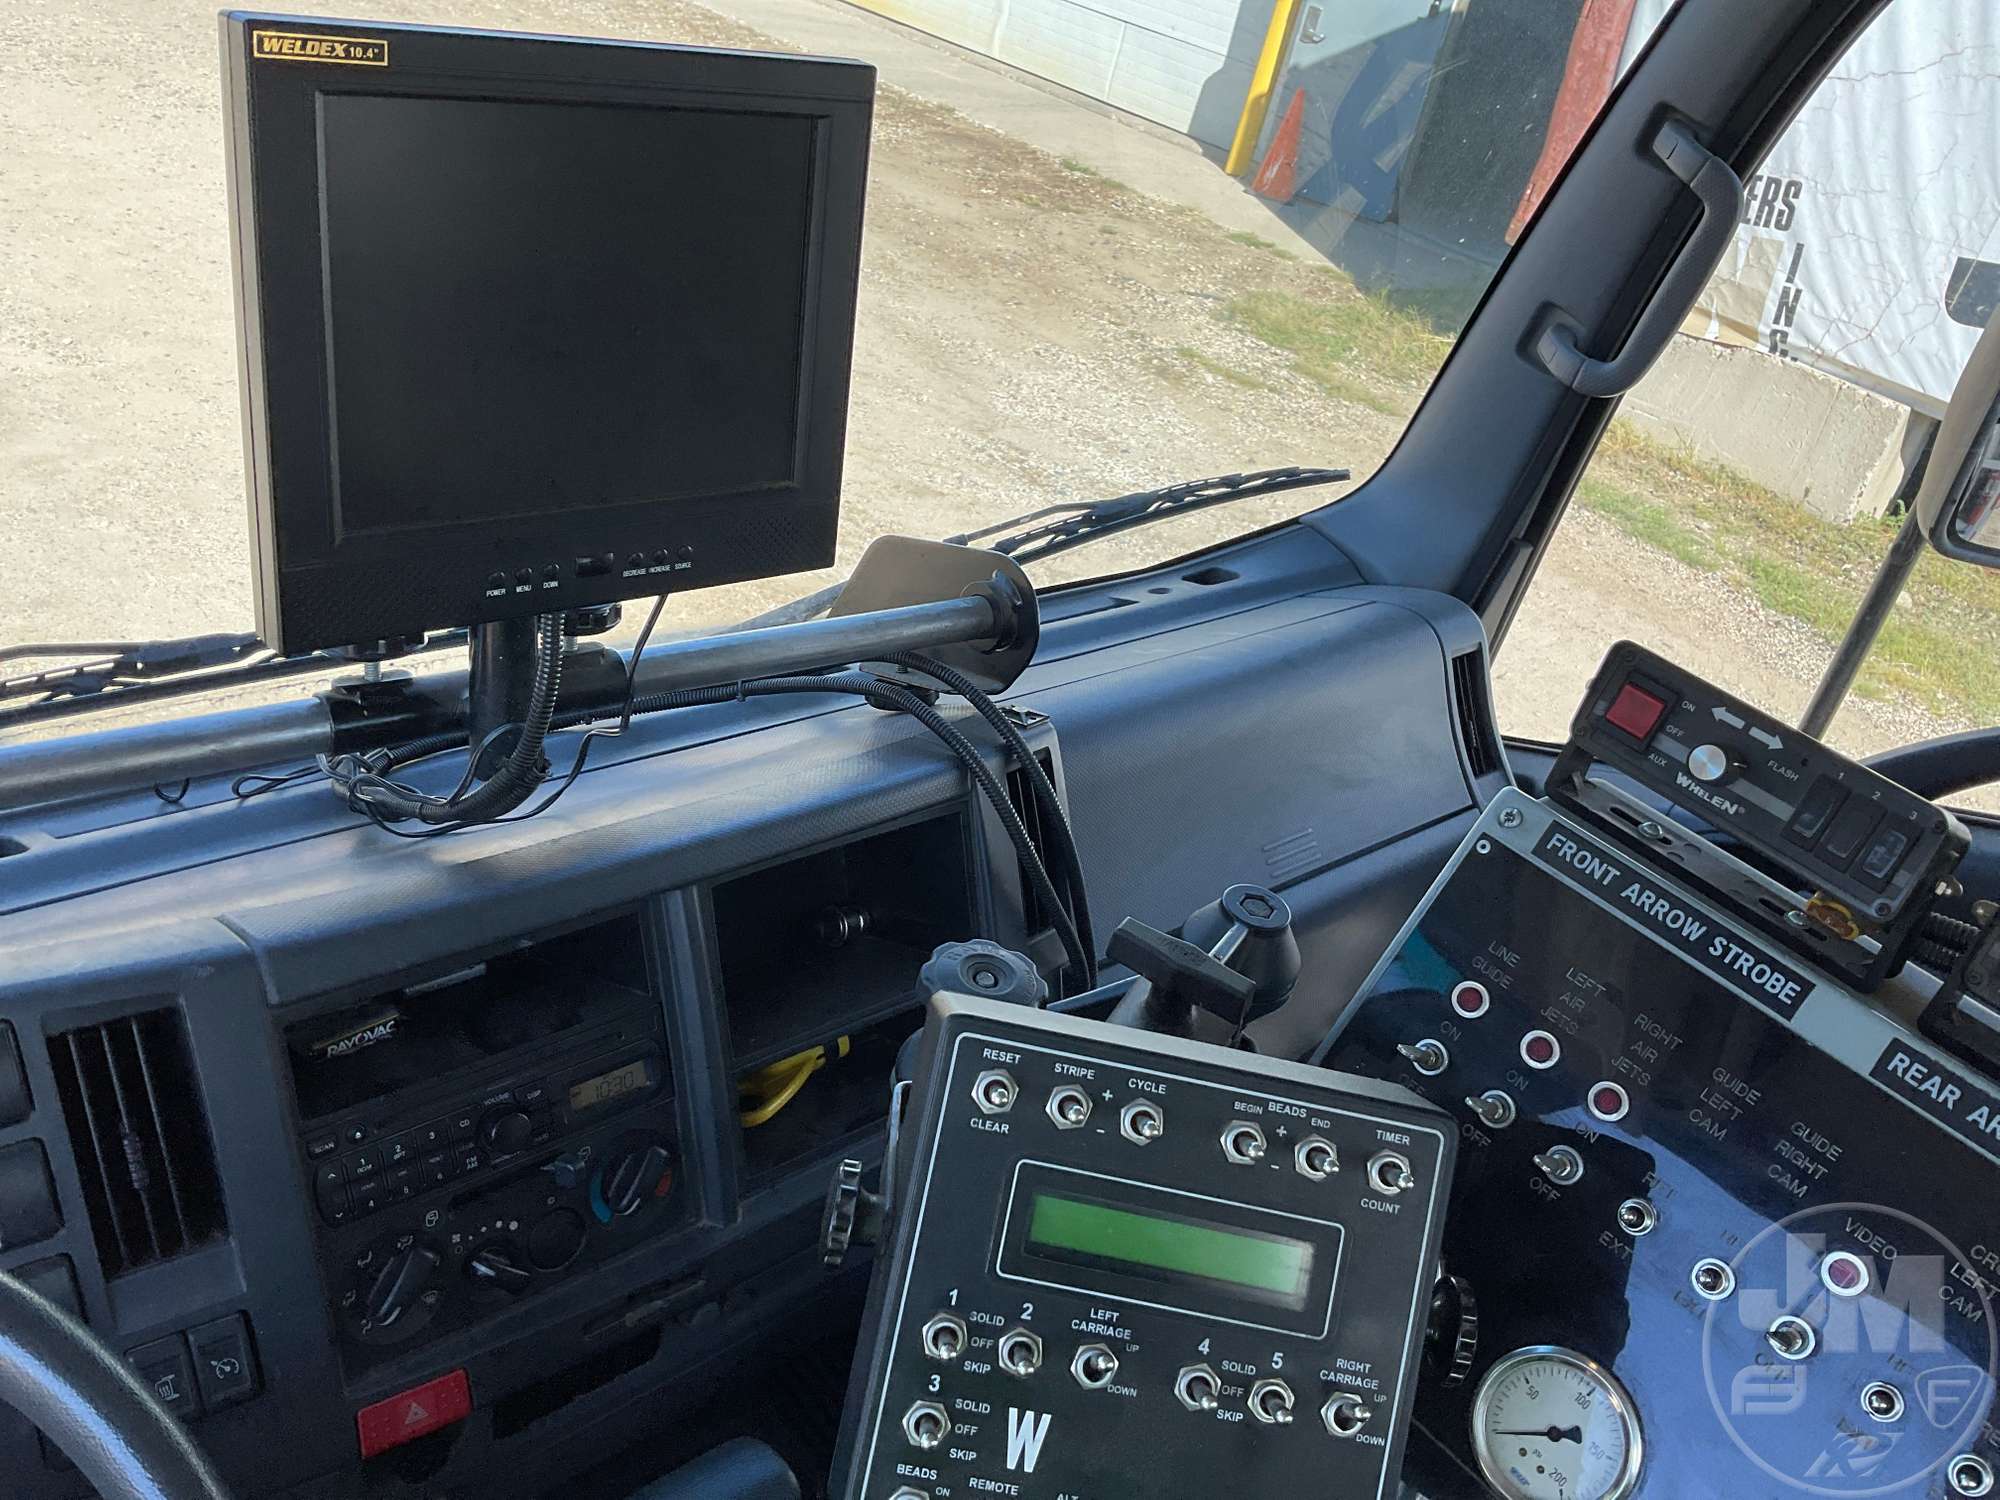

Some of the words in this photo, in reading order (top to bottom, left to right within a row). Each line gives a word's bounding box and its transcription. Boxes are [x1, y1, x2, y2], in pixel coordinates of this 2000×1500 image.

[262, 37, 348, 57] WELDEX
[349, 46, 379, 59] 10.4"
[674, 561, 692, 571] SOURCE
[486, 588, 506, 598] POWER
[516, 584, 532, 593] MENU
[543, 580, 559, 589] DOWN
[1681, 700, 1697, 713] ON
[1665, 724, 1686, 738] OFF
[1648, 752, 1668, 768] AUX
[1767, 759, 1800, 783] FLASH
[1871, 790, 1882, 801] 2
[1908, 810, 1919, 822] 3
[1546, 832, 1621, 887] FRONT
[1620, 882, 1708, 942] ARROW
[1708, 936, 1802, 1006] STROBE
[1487, 940, 1521, 968] LINE
[1471, 955, 1514, 990] GUIDE
[1565, 967, 1607, 998] LEFT
[1559, 990, 1586, 1013] AIR
[1540, 1005, 1580, 1035] JETS
[326, 1020, 396, 1058] RAYOVAC
[1439, 1020, 1463, 1042] ON
[1633, 1012, 1683, 1050] RIGHT
[982, 1047, 1021, 1064] RESET
[1630, 1040, 1659, 1064] AIR
[1054, 1062, 1096, 1080] STRIPE
[1505, 1069, 1529, 1092] ON
[1610, 1055, 1652, 1087] JETS
[1887, 1051, 1962, 1110] REAR
[1128, 1077, 1167, 1095] CYCLE
[1711, 1066, 1762, 1106] GUIDE
[1699, 1087, 1744, 1121] LEFT
[459, 1118, 470, 1128] CD
[1233, 1100, 1263, 1116] BEGIN
[1267, 1101, 1308, 1118] BEADS
[1311, 1116, 1331, 1129] END
[970, 1117, 1009, 1134] CLEAR
[1575, 1122, 1600, 1145] ON
[1688, 1108, 1728, 1142] CAM
[1375, 1129, 1411, 1146] TIMER
[1461, 1123, 1492, 1148] OFF
[1790, 1120, 1843, 1162] GUIDE
[1773, 1139, 1829, 1181] RIGHT
[1528, 1177, 1561, 1201] OFF
[1767, 1163, 1809, 1199] CAM
[1360, 1198, 1401, 1216] COUNT
[1597, 1229, 1633, 1260] EXT
[1844, 1216, 1898, 1261] VIDEO
[1970, 1244, 2000, 1275] CR
[1950, 1261, 2000, 1300] LEFT
[949, 1288, 959, 1306] 1
[1938, 1285, 1984, 1322] CAM
[969, 1310, 1005, 1327] SOLID
[1020, 1302, 1034, 1320] 2
[1090, 1307, 1120, 1323] LEFT
[1071, 1319, 1133, 1340] CARRIAGE
[970, 1336, 995, 1350] OFF
[1126, 1342, 1140, 1353] UP
[1197, 1337, 1210, 1356] 4
[963, 1360, 991, 1375] SKIP
[1221, 1359, 1256, 1376] SOLID
[1271, 1352, 1284, 1370] 5
[1336, 1357, 1372, 1375] RIGHT
[928, 1374, 941, 1393] 3
[1319, 1369, 1380, 1391] CARRIAGE
[1106, 1383, 1138, 1398] DOWN
[1221, 1384, 1245, 1398] OFF
[1373, 1392, 1388, 1403] UP
[1525, 1385, 1540, 1401] 50
[954, 1398, 991, 1415] SOLID
[1573, 1391, 1591, 1411] 100
[1216, 1408, 1244, 1424] SKIP
[954, 1423, 979, 1437] OFF
[1006, 1406, 1053, 1474] W
[1355, 1433, 1386, 1447] DOWN
[1588, 1440, 1604, 1459] 150
[949, 1447, 977, 1462] SKIP
[896, 1463, 938, 1481] BEADS
[1547, 1466, 1568, 1487] 200
[935, 1485, 951, 1498] ON
[968, 1477, 1020, 1497] REMOTE
